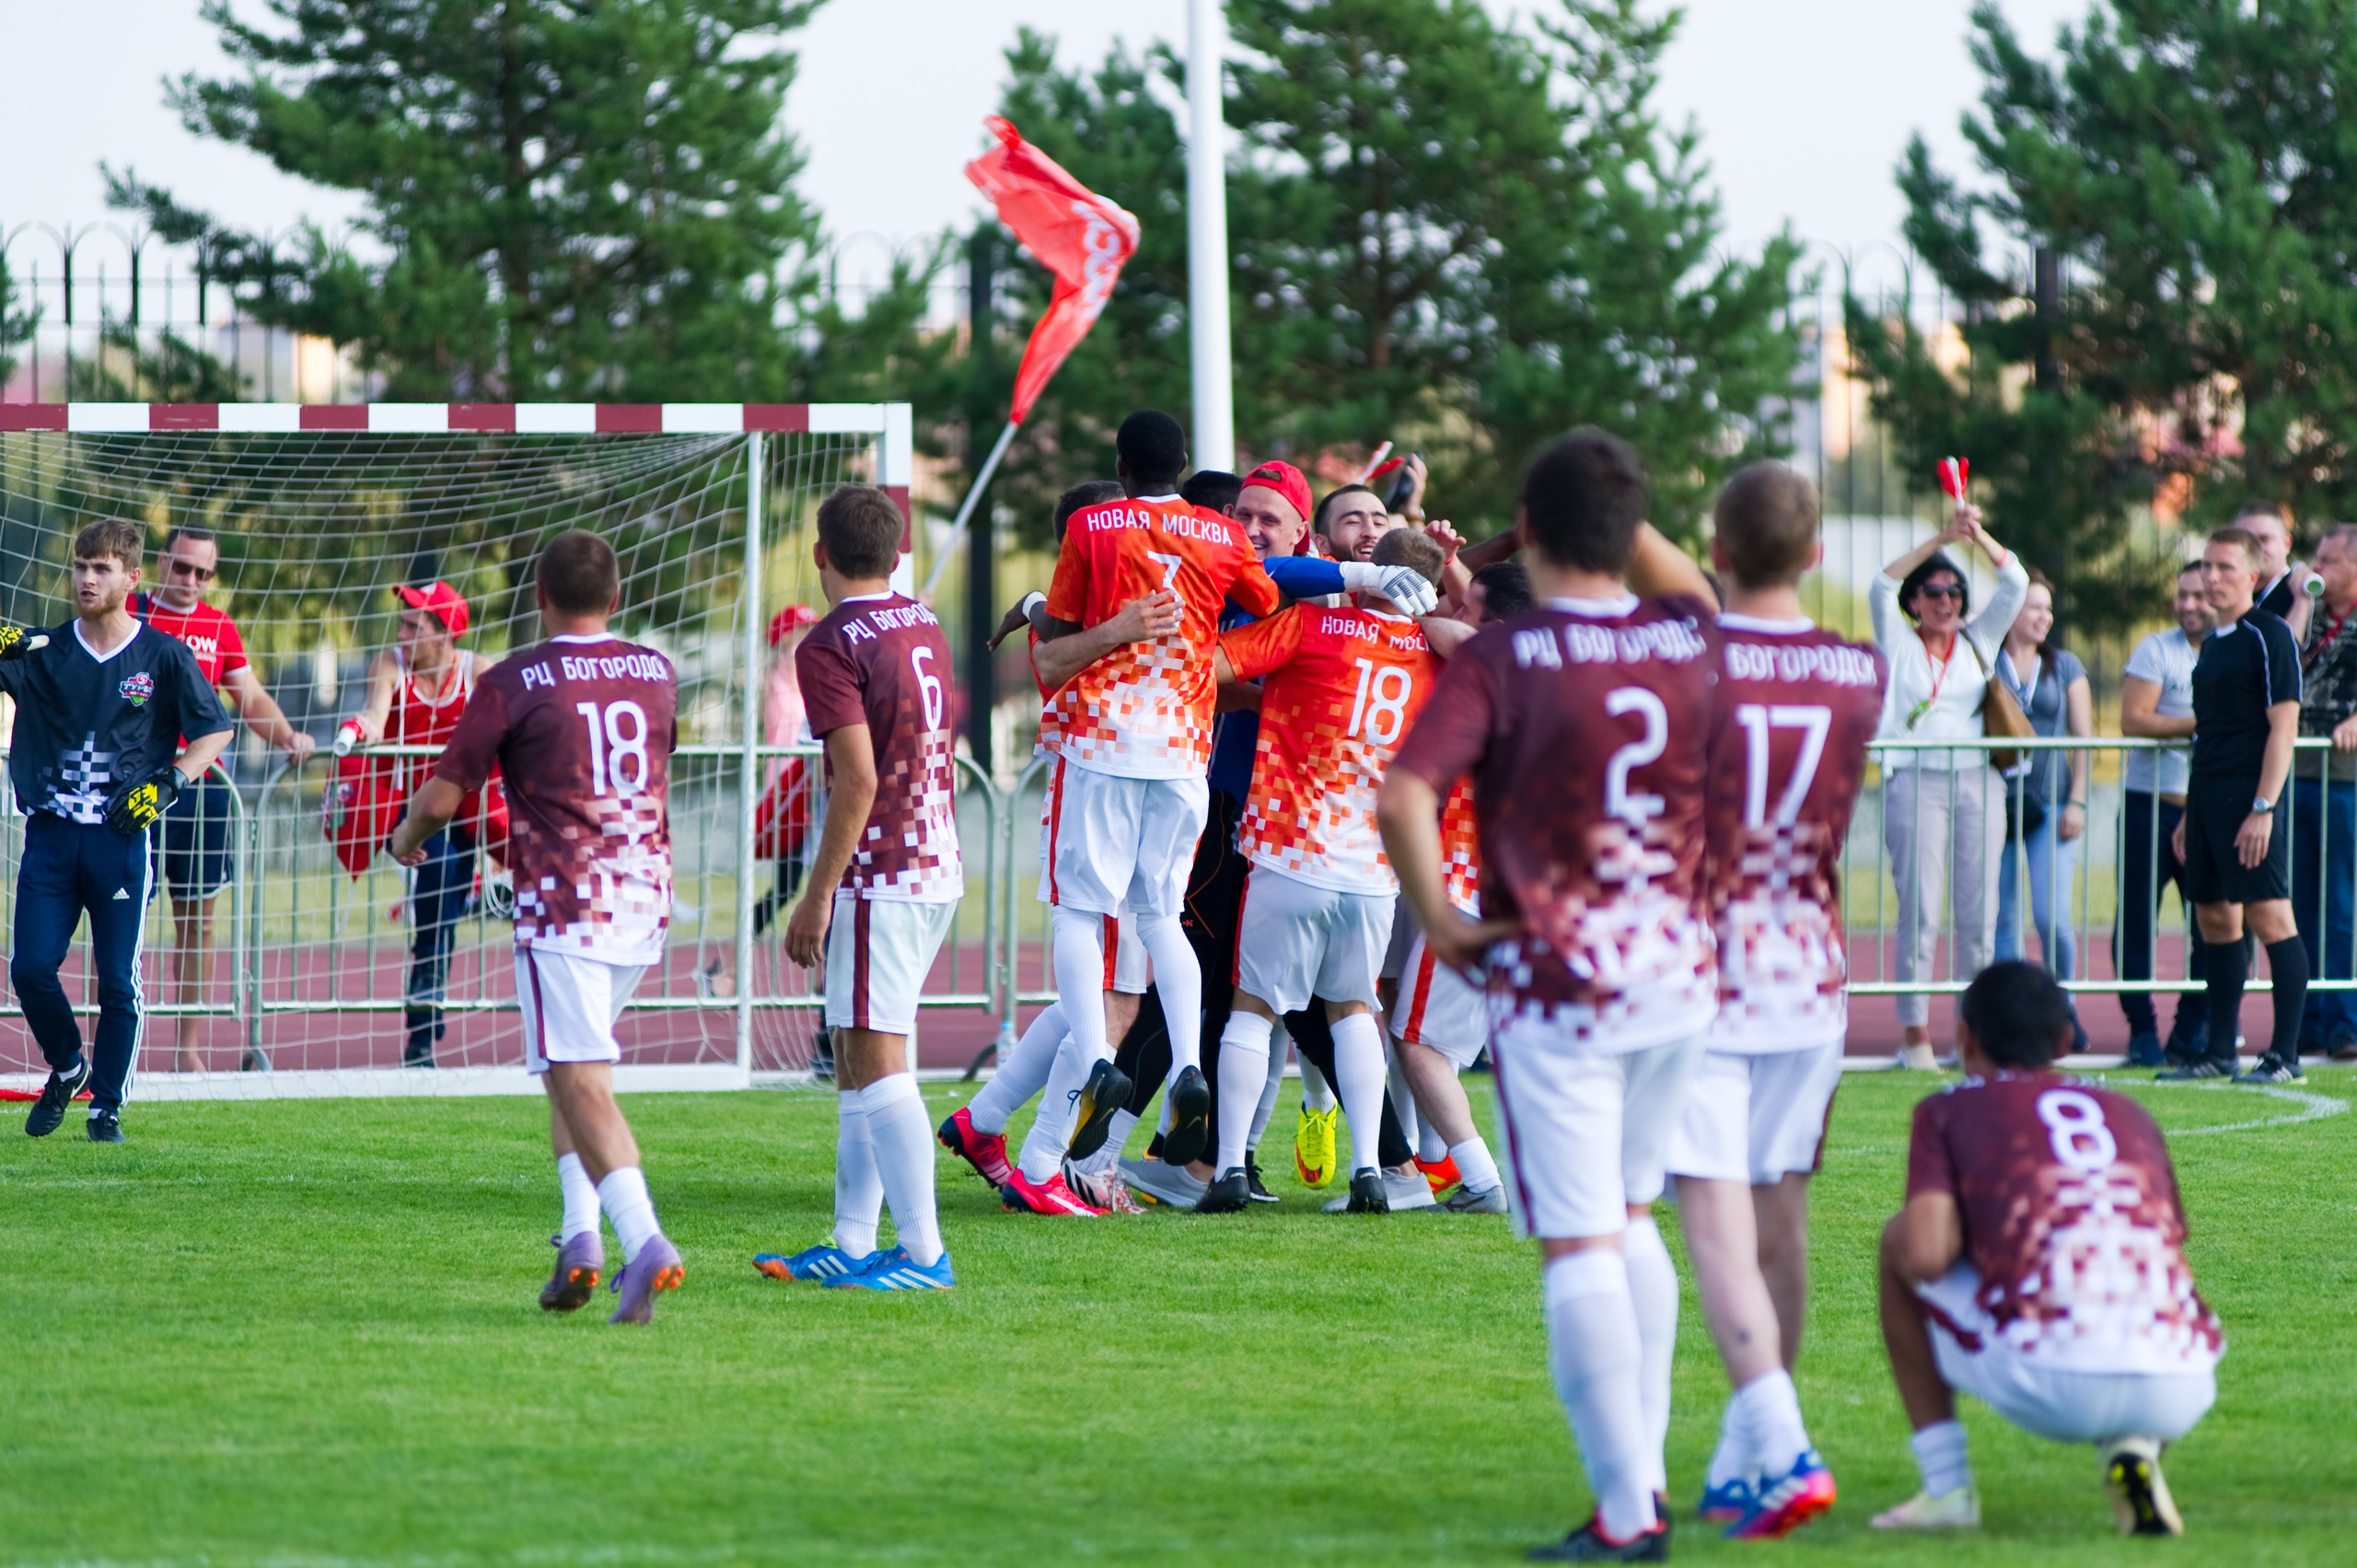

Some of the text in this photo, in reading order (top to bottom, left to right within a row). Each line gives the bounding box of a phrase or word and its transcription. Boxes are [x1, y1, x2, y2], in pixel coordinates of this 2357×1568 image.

[1086, 508, 1233, 547] НОВАЯ МОСКВА
[842, 618, 877, 645] РЦ
[1321, 616, 1379, 644] НОВАЯ
[1511, 626, 1562, 670] РЦ
[520, 660, 556, 691] РЦ
[911, 645, 943, 735] 6
[1347, 656, 1411, 746] 18
[575, 700, 648, 797] 18
[1605, 686, 1668, 819] 2
[1736, 703, 1833, 830] 17
[2036, 1087, 2118, 1170] 8
